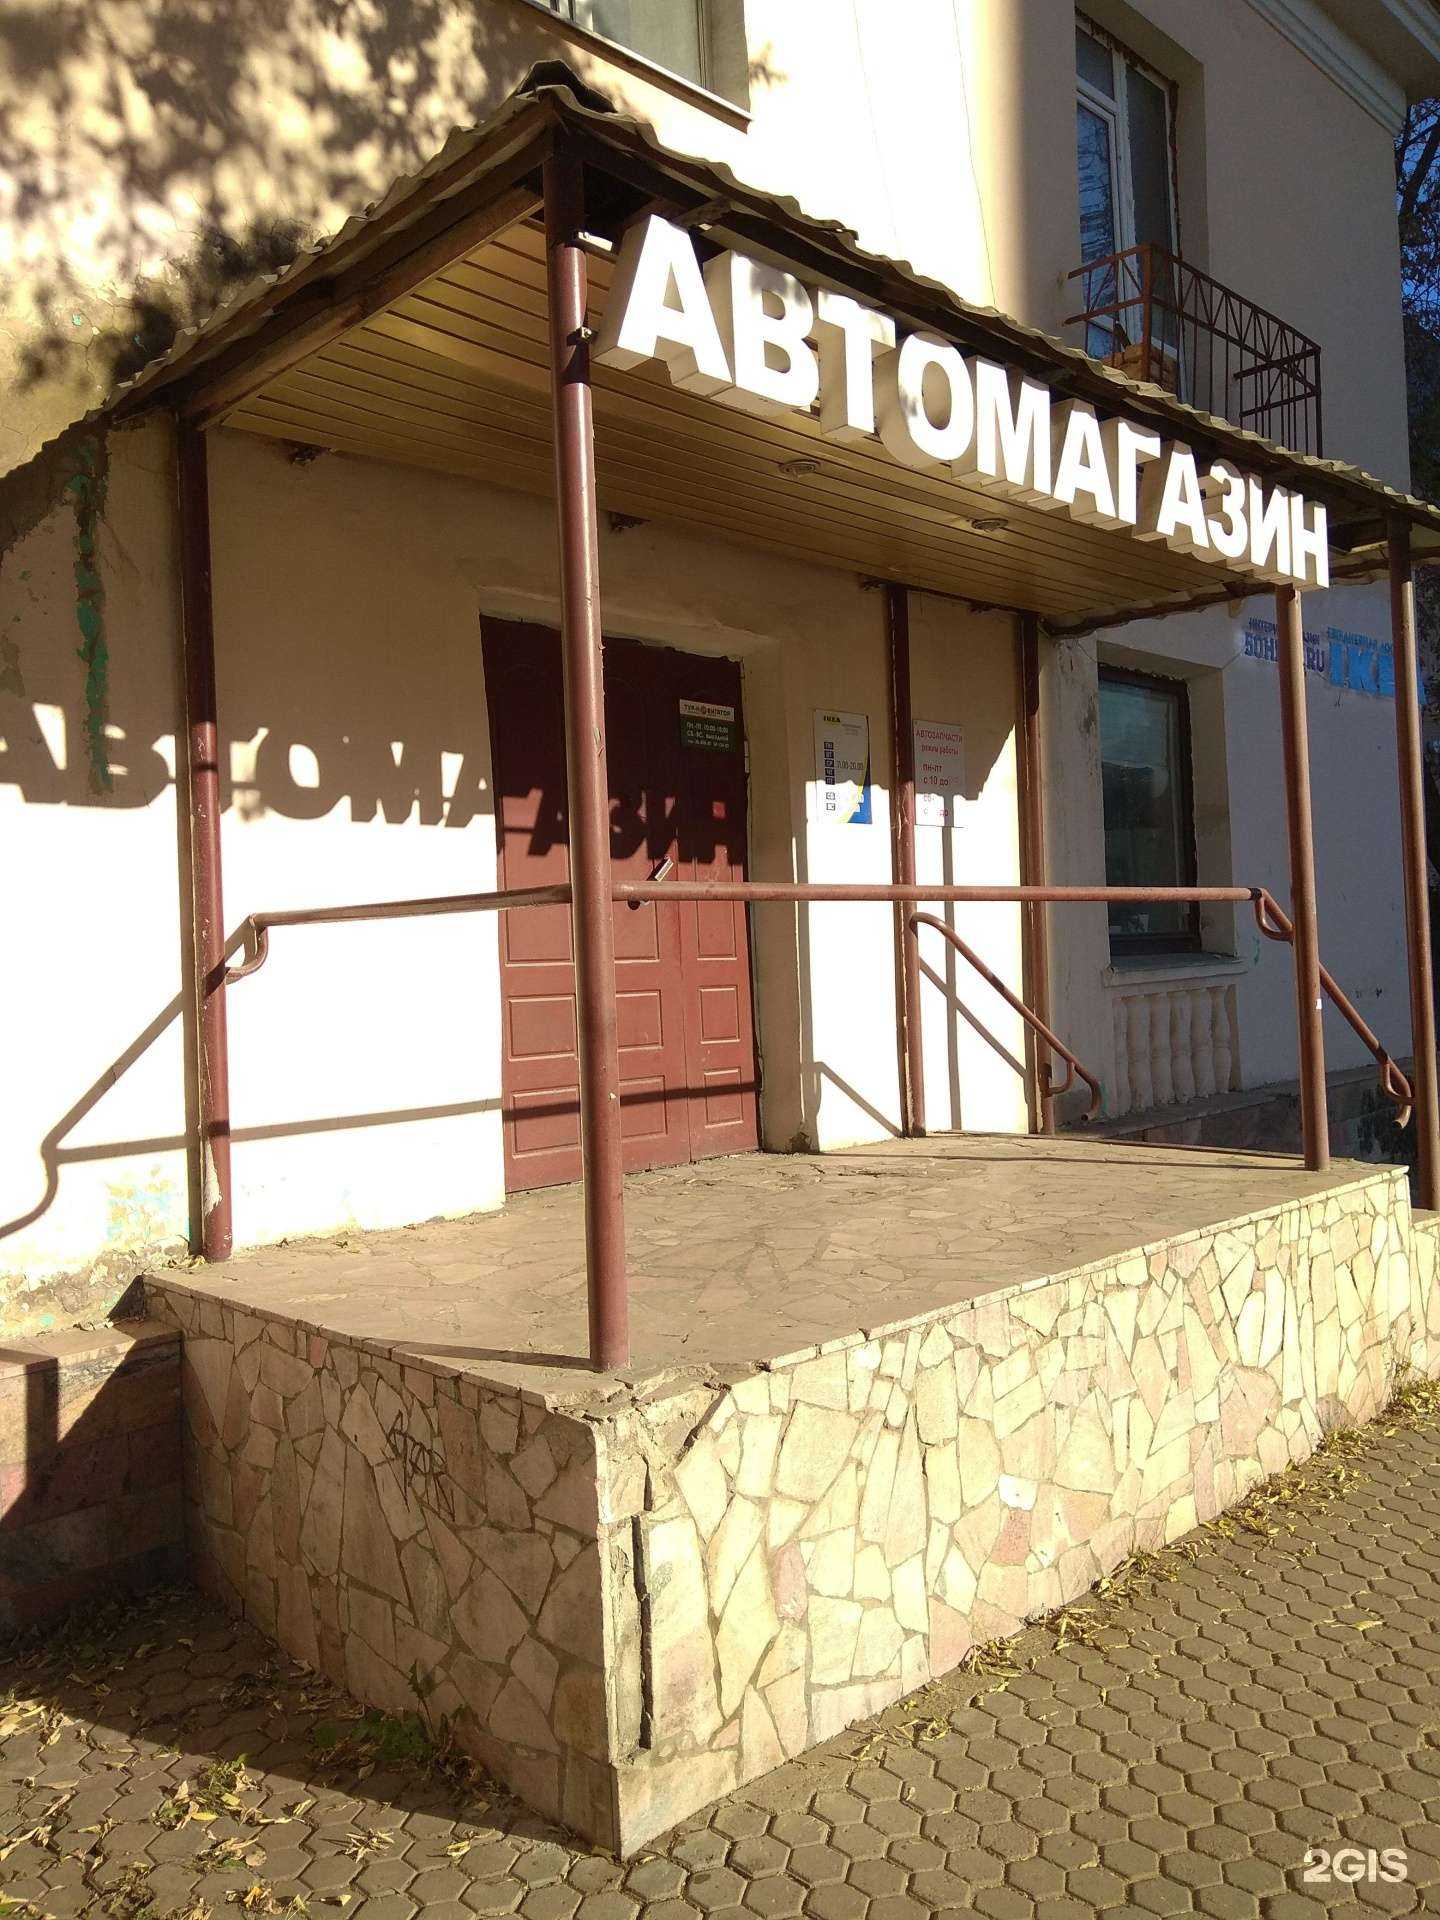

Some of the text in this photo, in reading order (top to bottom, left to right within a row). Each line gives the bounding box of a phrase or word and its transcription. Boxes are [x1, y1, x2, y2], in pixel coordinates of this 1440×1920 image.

[616, 214, 1329, 589] АВТОМАГАЗИН
[915, 729, 963, 743] АВТОЗАПЧАСТИ
[939, 746, 959, 757] работы
